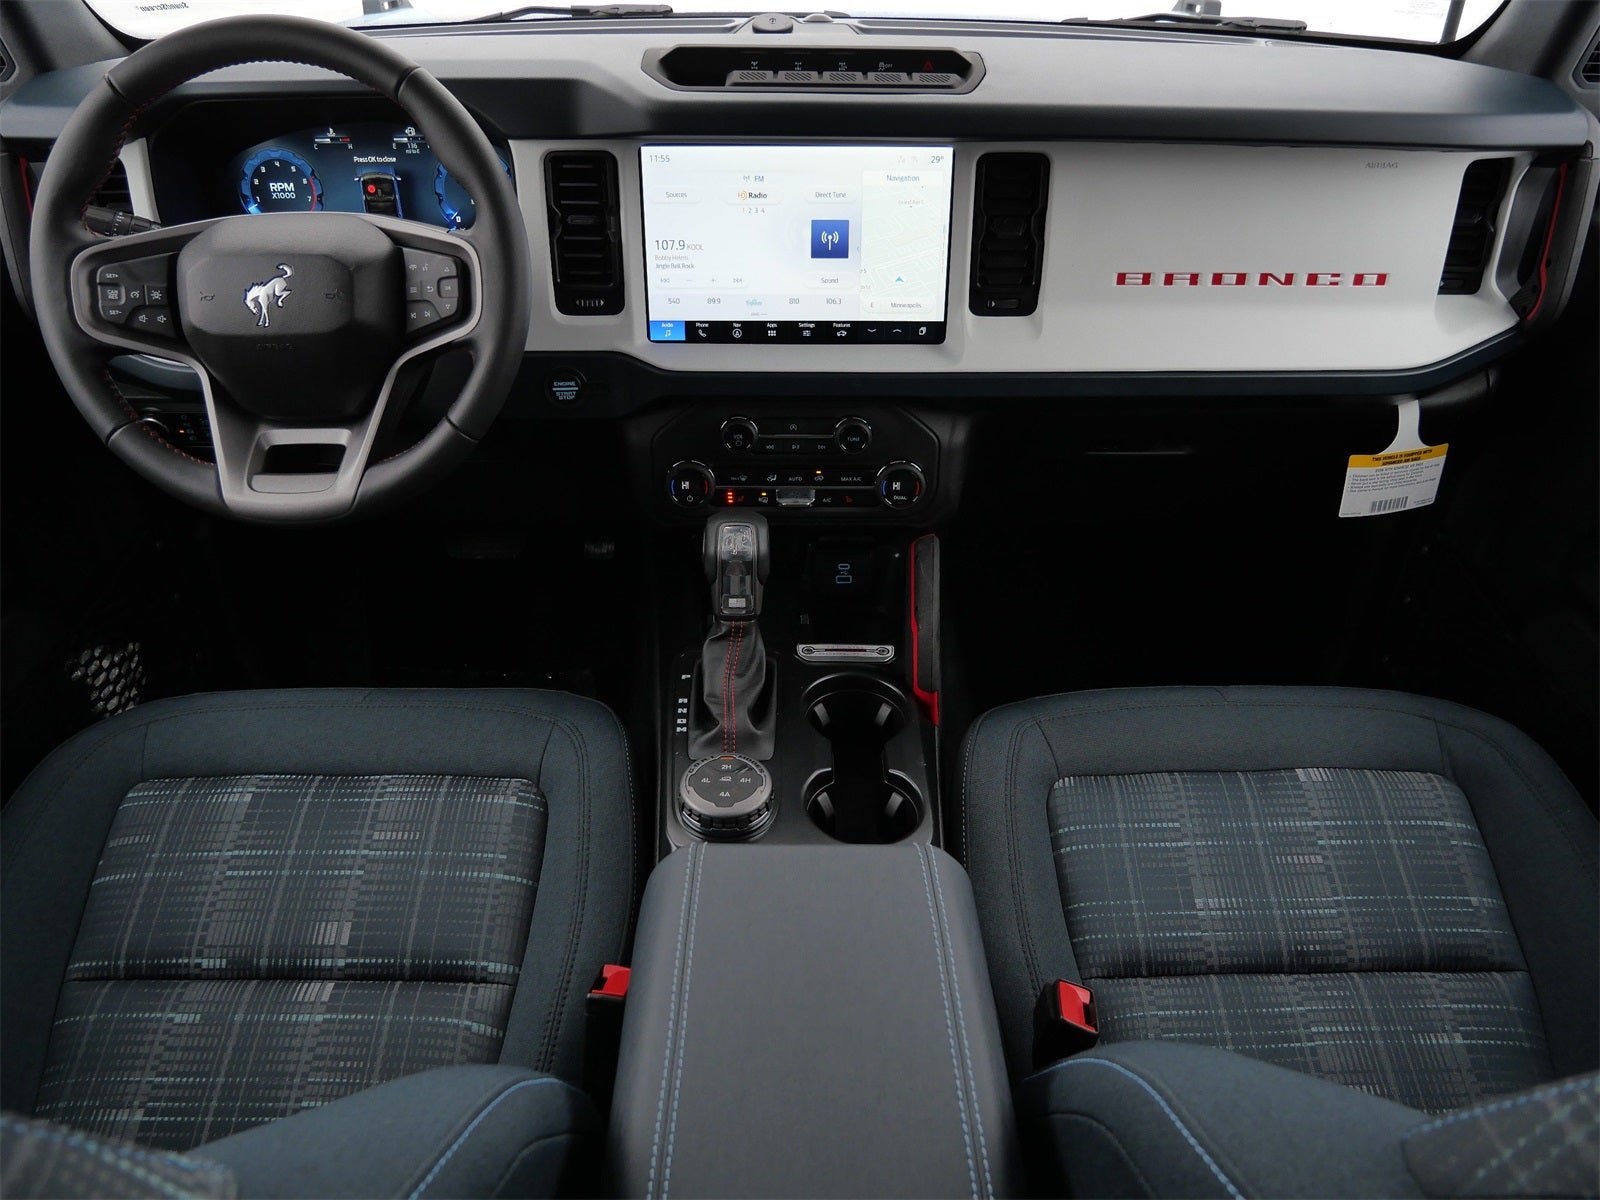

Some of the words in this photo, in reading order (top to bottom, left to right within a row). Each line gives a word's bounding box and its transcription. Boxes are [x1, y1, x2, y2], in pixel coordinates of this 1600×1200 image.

[648, 154, 670, 164] 11:55
[754, 174, 765, 183] FM
[886, 174, 920, 184] Navigation
[269, 182, 295, 192] RPM
[665, 190, 688, 199] Sources
[748, 191, 768, 199] Radio
[654, 239, 686, 251] 107.9
[1114, 272, 1389, 286] BRONCO
[681, 481, 690, 490] HI
[893, 482, 901, 490] HI
